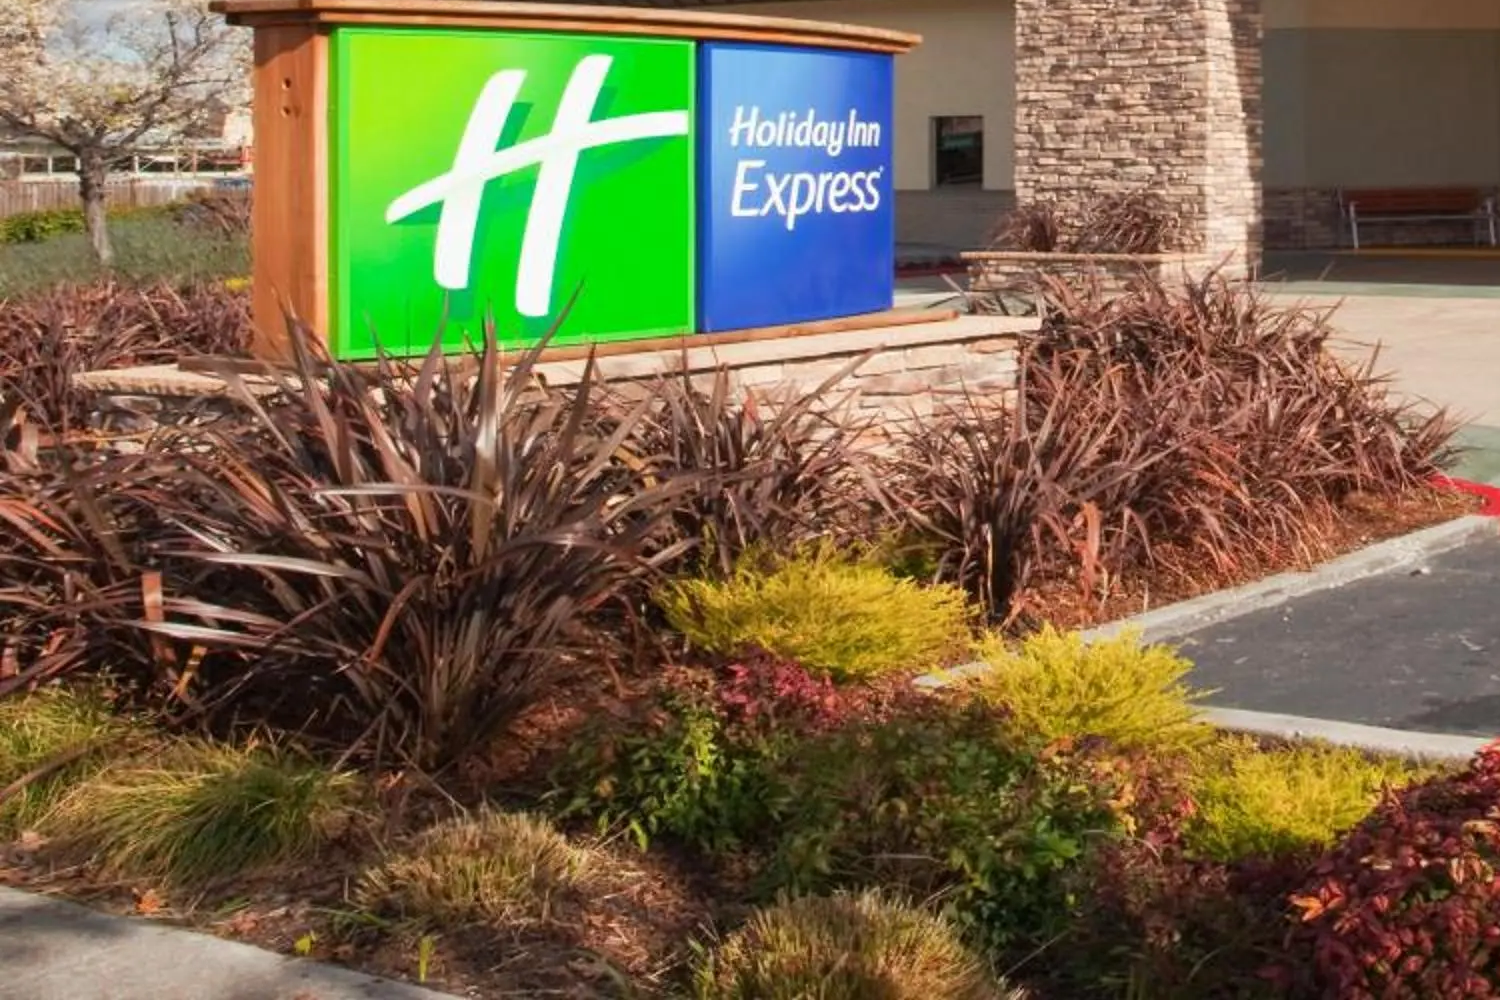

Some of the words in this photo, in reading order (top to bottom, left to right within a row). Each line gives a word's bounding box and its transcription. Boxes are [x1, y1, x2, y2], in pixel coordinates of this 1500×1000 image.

[729, 105, 845, 157] Holiday
[847, 108, 881, 147] Inn
[730, 159, 882, 231] Express
